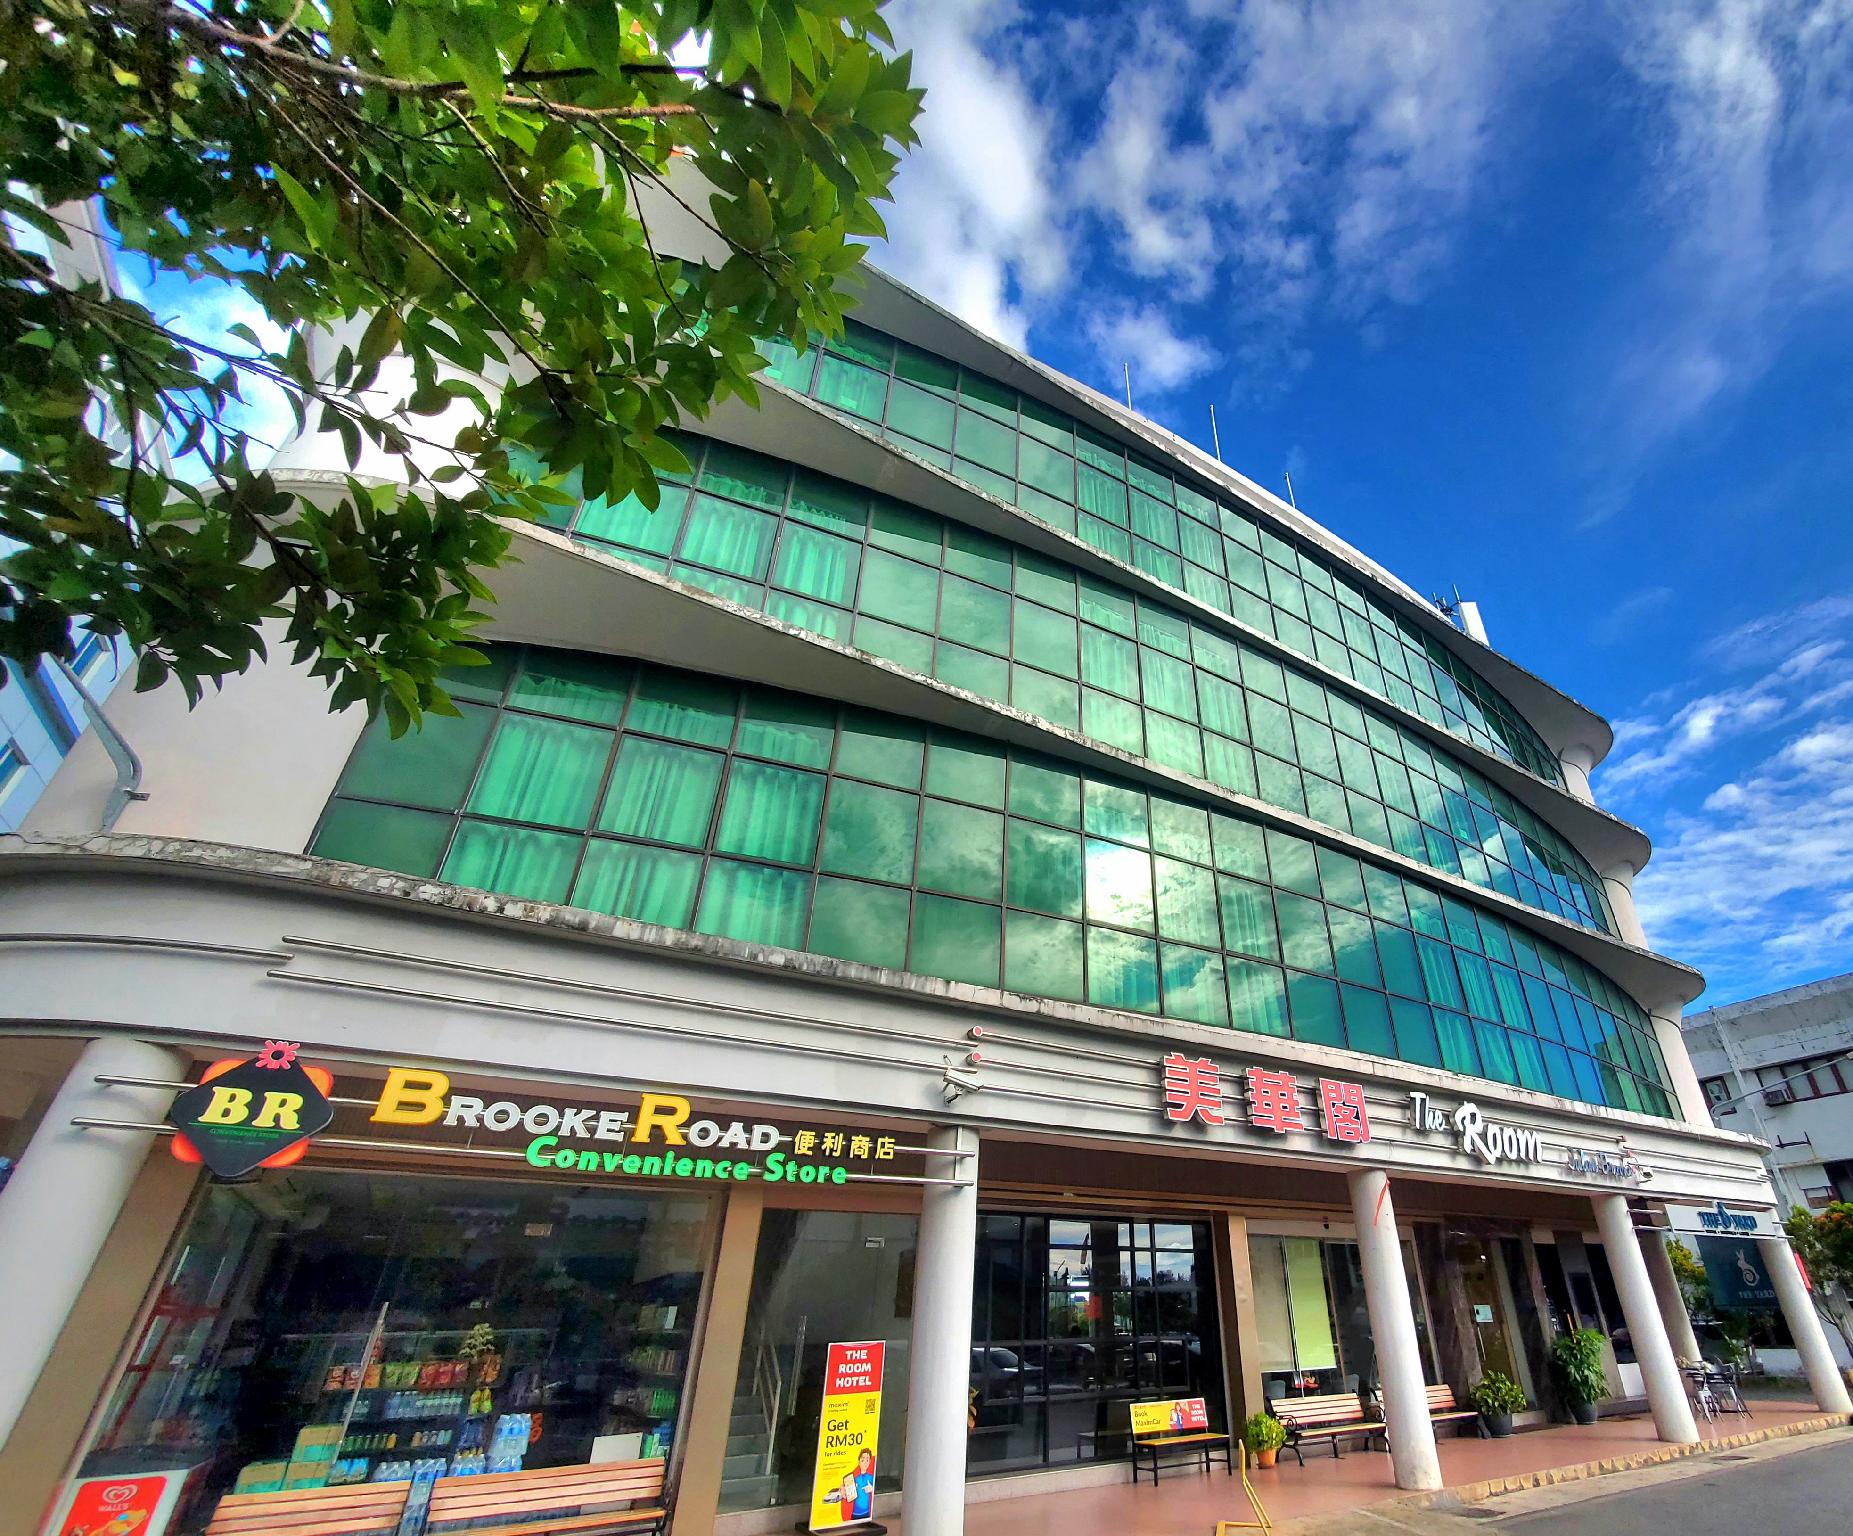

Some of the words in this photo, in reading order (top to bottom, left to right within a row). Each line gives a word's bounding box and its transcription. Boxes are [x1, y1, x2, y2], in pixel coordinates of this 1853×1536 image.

[198, 1086, 304, 1130] BR
[370, 1067, 629, 1142] BROOKE
[630, 1092, 780, 1151] ROAD
[1163, 1052, 1371, 1143] 美華閣
[1409, 1091, 1446, 1131] The
[525, 1135, 750, 1181] Convenience
[763, 1152, 848, 1185] Store
[793, 1129, 897, 1160] 便利商店
[839, 1362, 871, 1373] ROOM
[846, 1350, 867, 1359] THE
[836, 1376, 871, 1387] HOTEL
[827, 1419, 850, 1432] Get
